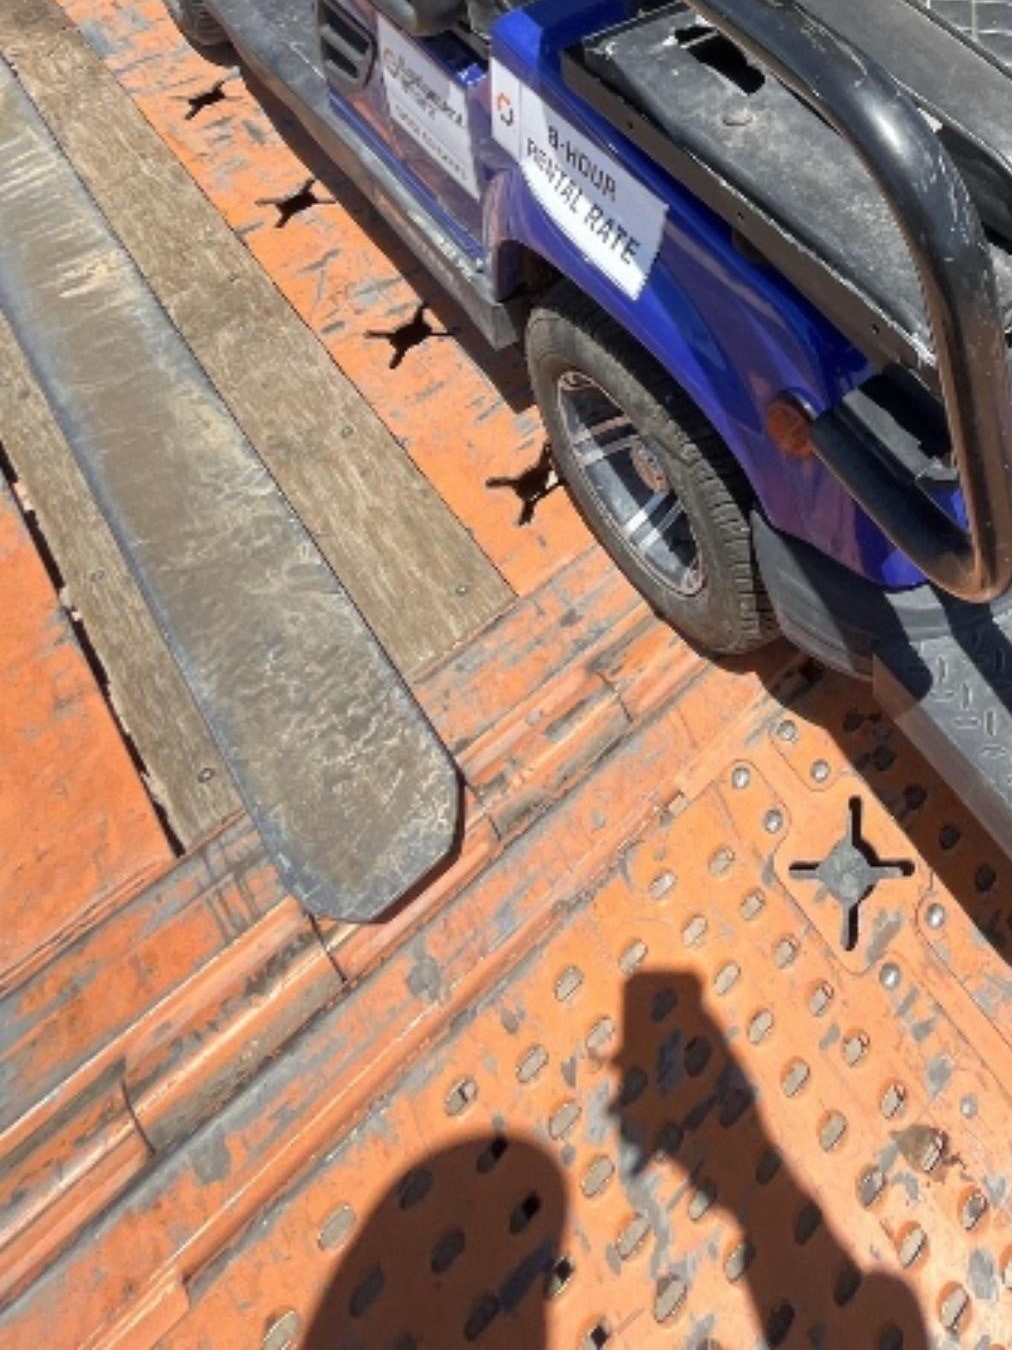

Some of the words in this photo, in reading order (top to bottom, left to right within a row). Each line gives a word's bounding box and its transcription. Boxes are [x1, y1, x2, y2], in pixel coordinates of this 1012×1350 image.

[526, 136, 582, 216] RENTAL
[583, 205, 641, 267] RATE
[547, 124, 617, 203] 8-HOUR
